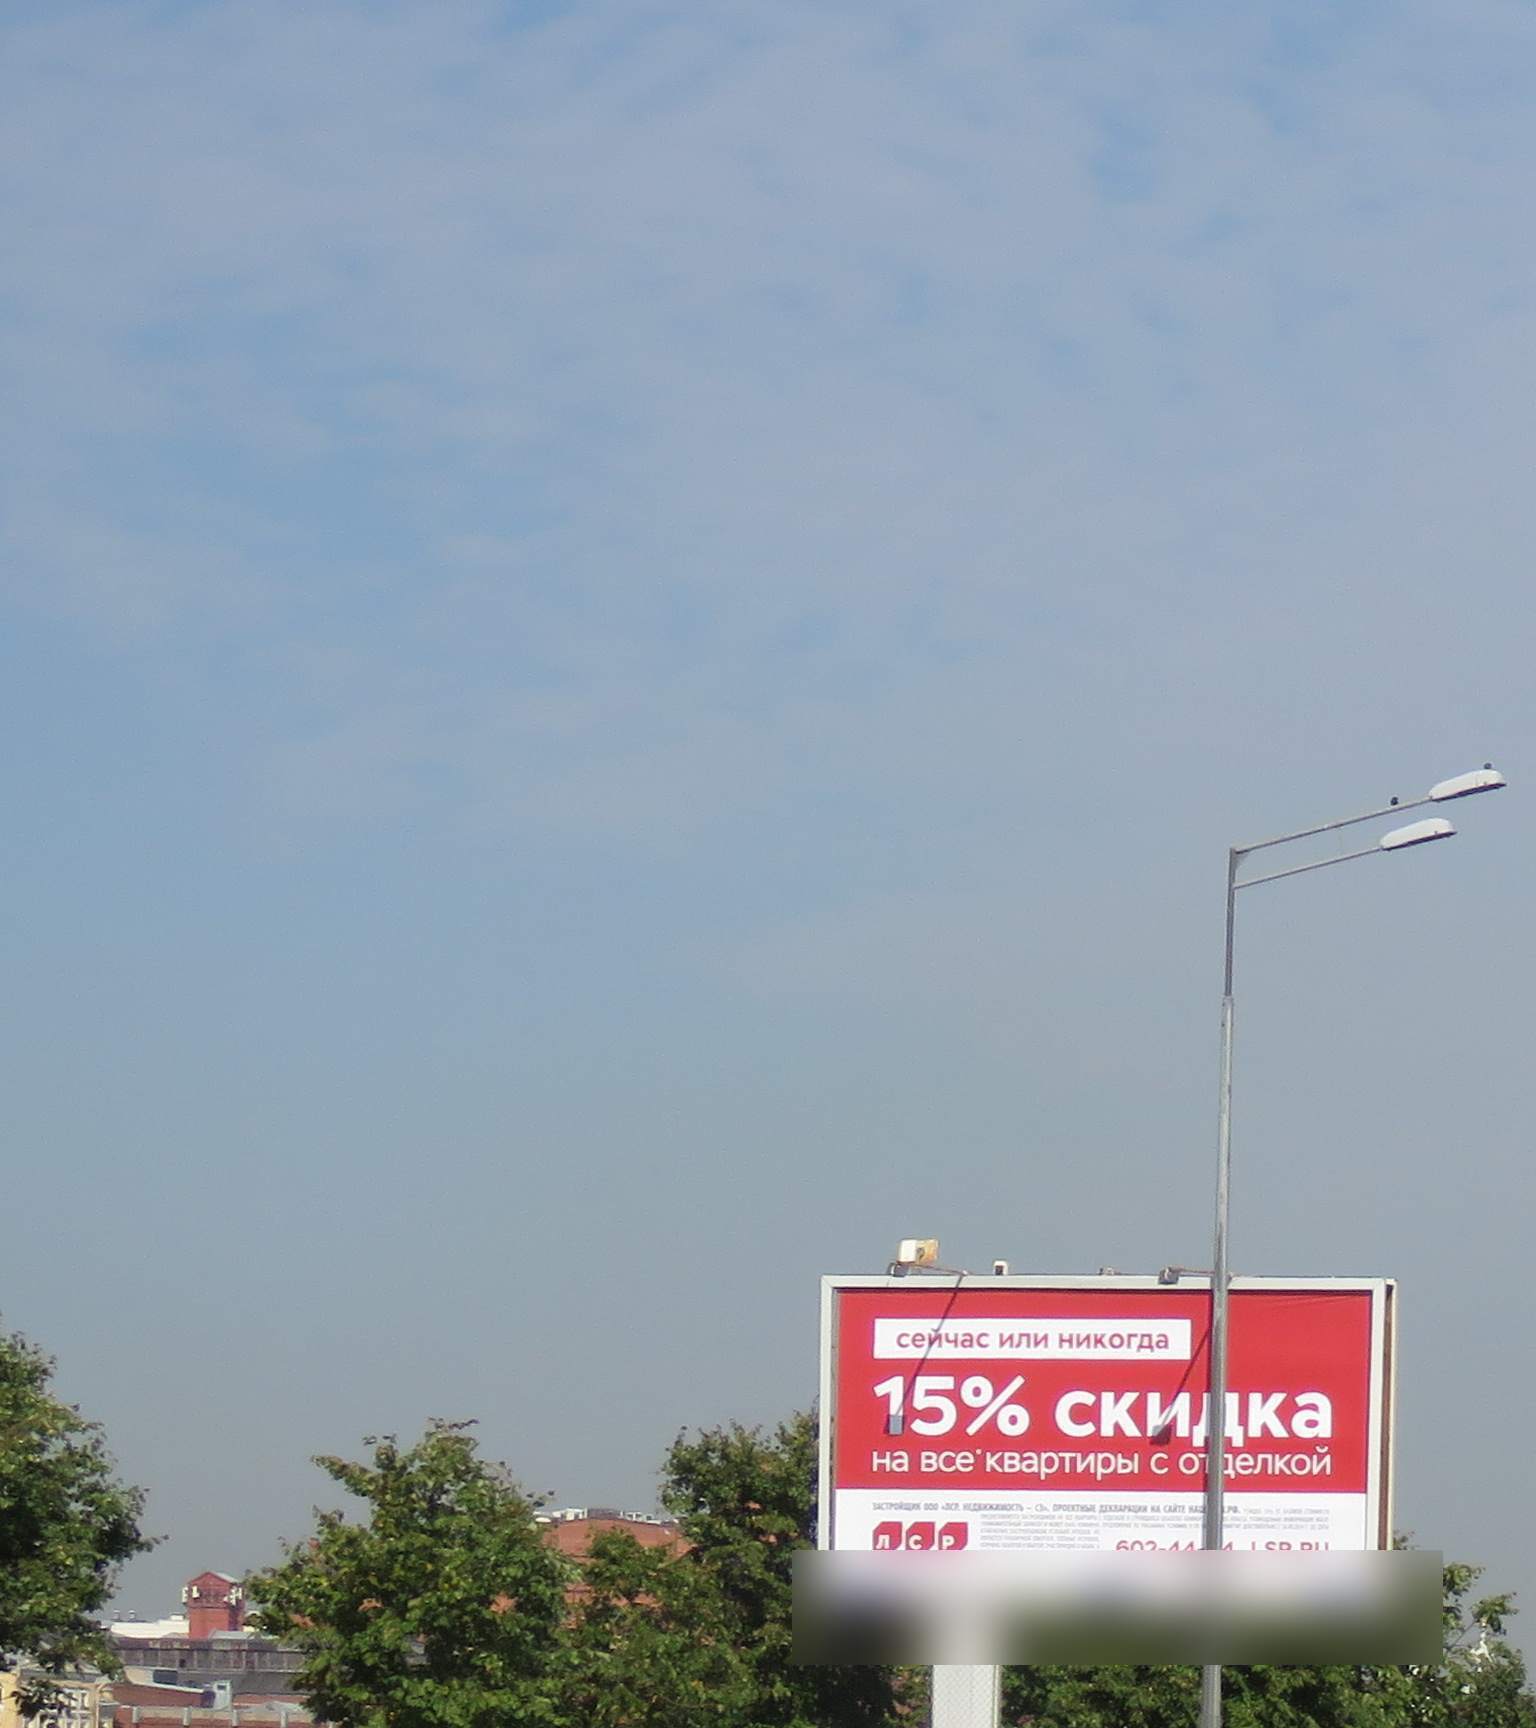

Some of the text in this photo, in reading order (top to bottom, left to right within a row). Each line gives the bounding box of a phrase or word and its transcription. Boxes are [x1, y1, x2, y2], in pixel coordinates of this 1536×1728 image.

[896, 1327, 1169, 1352] сейчас или никогда
[872, 1374, 1333, 1447] 15% скидка
[872, 1450, 909, 1473] на
[985, 1451, 1140, 1480] квартиры
[1150, 1452, 1169, 1475] с
